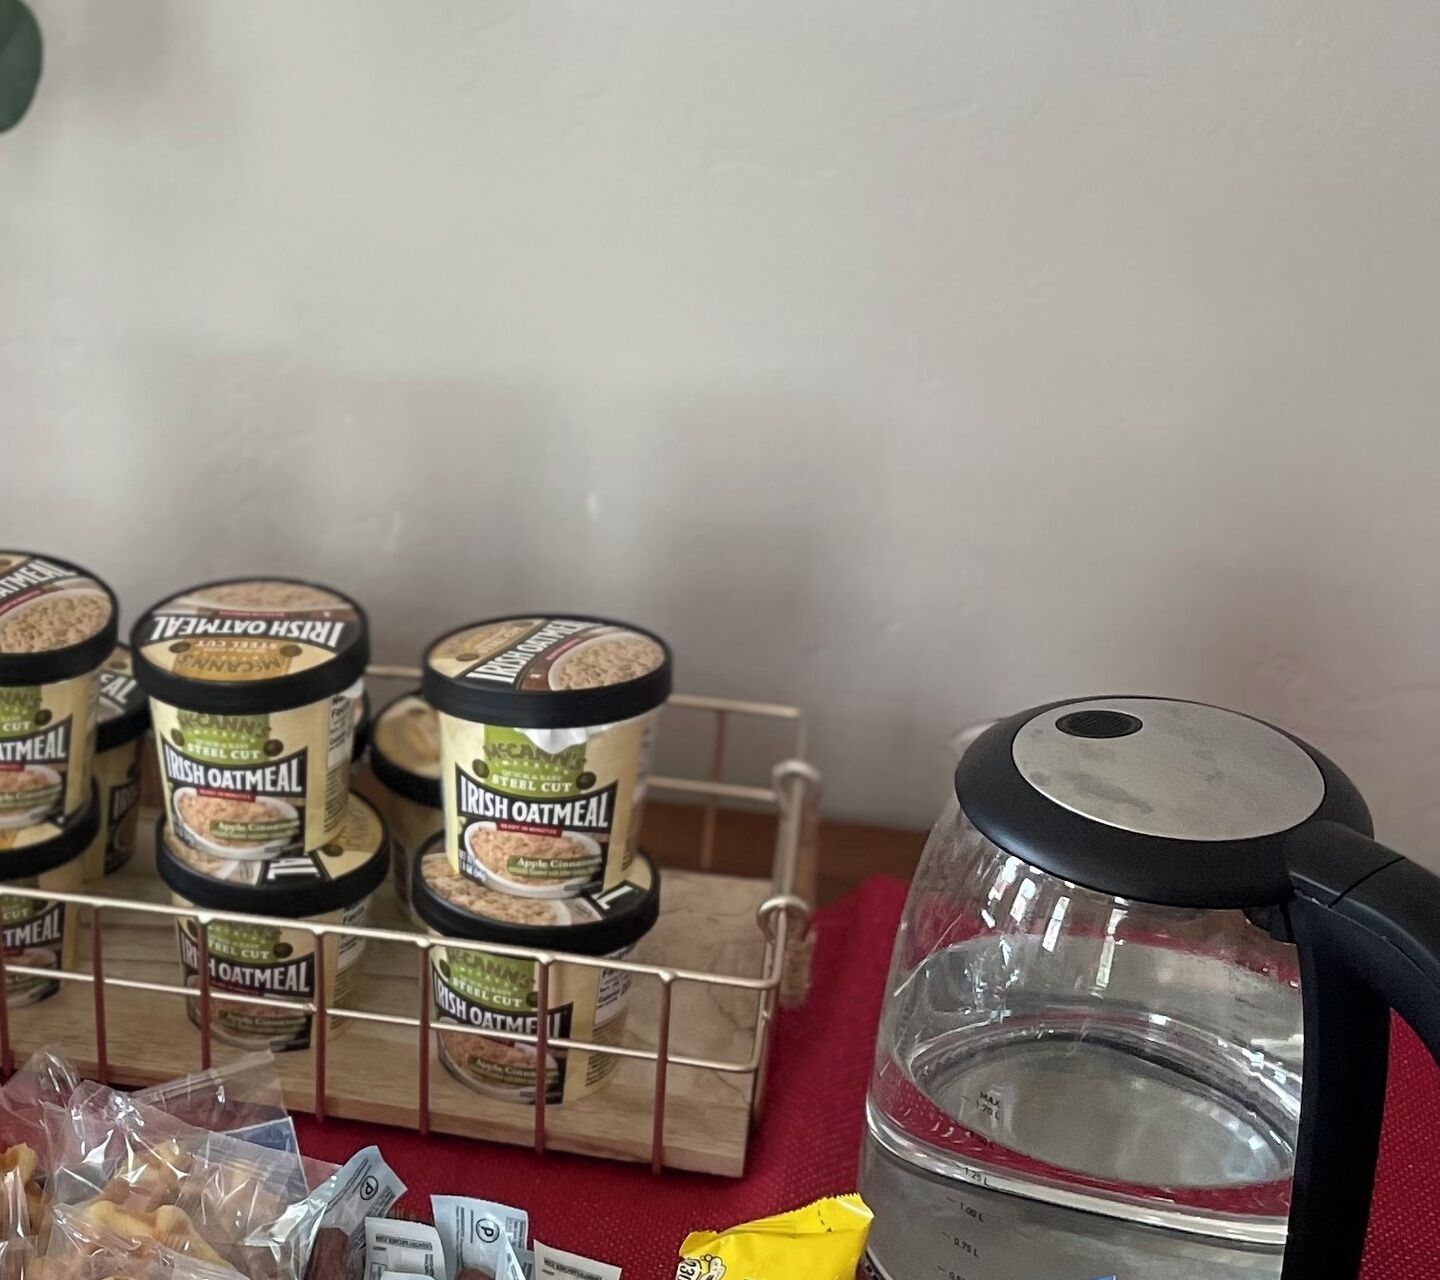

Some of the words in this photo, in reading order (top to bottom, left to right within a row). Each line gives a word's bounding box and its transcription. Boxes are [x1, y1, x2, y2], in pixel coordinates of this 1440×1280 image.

[150, 616, 266, 640] OATMEAL
[269, 621, 345, 648] IRISH
[465, 650, 521, 684] IRISH
[2, 720, 31, 731] CUT
[187, 743, 227, 759] STEEL
[231, 749, 260, 760] CUT
[164, 743, 205, 782] IRISH
[208, 757, 303, 793] OATMEAL
[491, 774, 537, 792] STEEL
[541, 782, 572, 793] CUT
[461, 776, 508, 819] IRISH
[512, 792, 609, 828] OATMEAL
[517, 857, 547, 870] Apple
[241, 948, 270, 960] CUT
[219, 962, 310, 993] OATMEAL
[433, 971, 468, 1020] IRISH
[452, 976, 490, 1000] STEEL
[492, 994, 522, 1008] CUT
